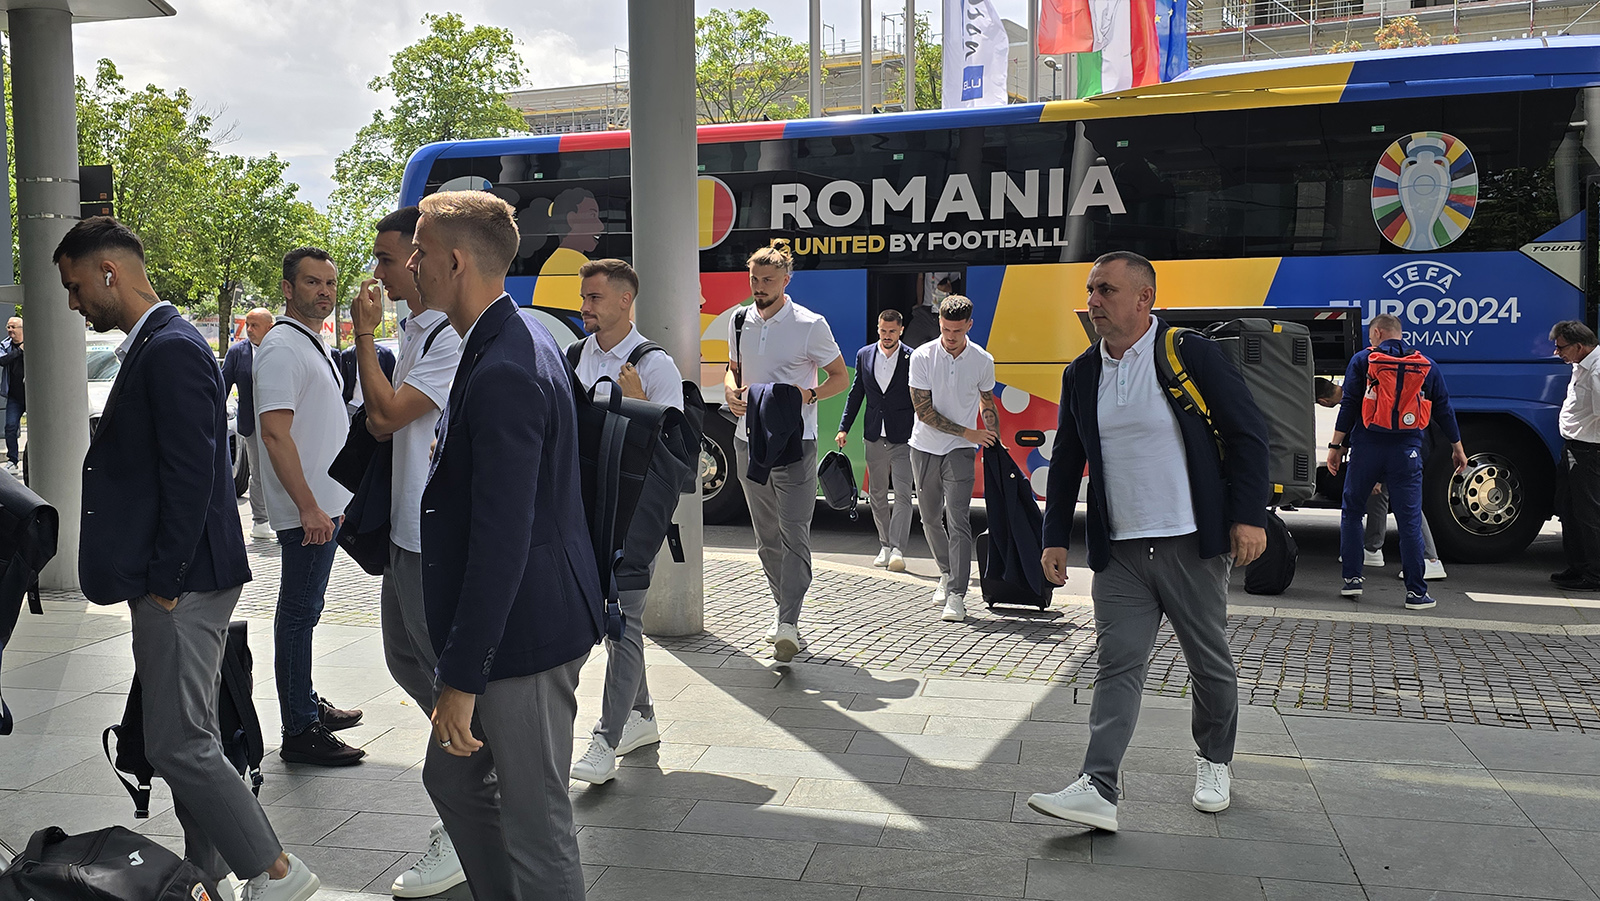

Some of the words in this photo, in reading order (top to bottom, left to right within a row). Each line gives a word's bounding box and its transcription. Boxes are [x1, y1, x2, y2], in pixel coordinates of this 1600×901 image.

[770, 165, 1127, 229] ROMANIA
[795, 235, 885, 255] UNITED
[889, 233, 924, 252] BY
[928, 228, 1069, 251] FOOTBALL
[1386, 266, 1453, 289] UEFA
[1329, 297, 1521, 324] URO2024
[1402, 330, 1474, 346] RMANY
